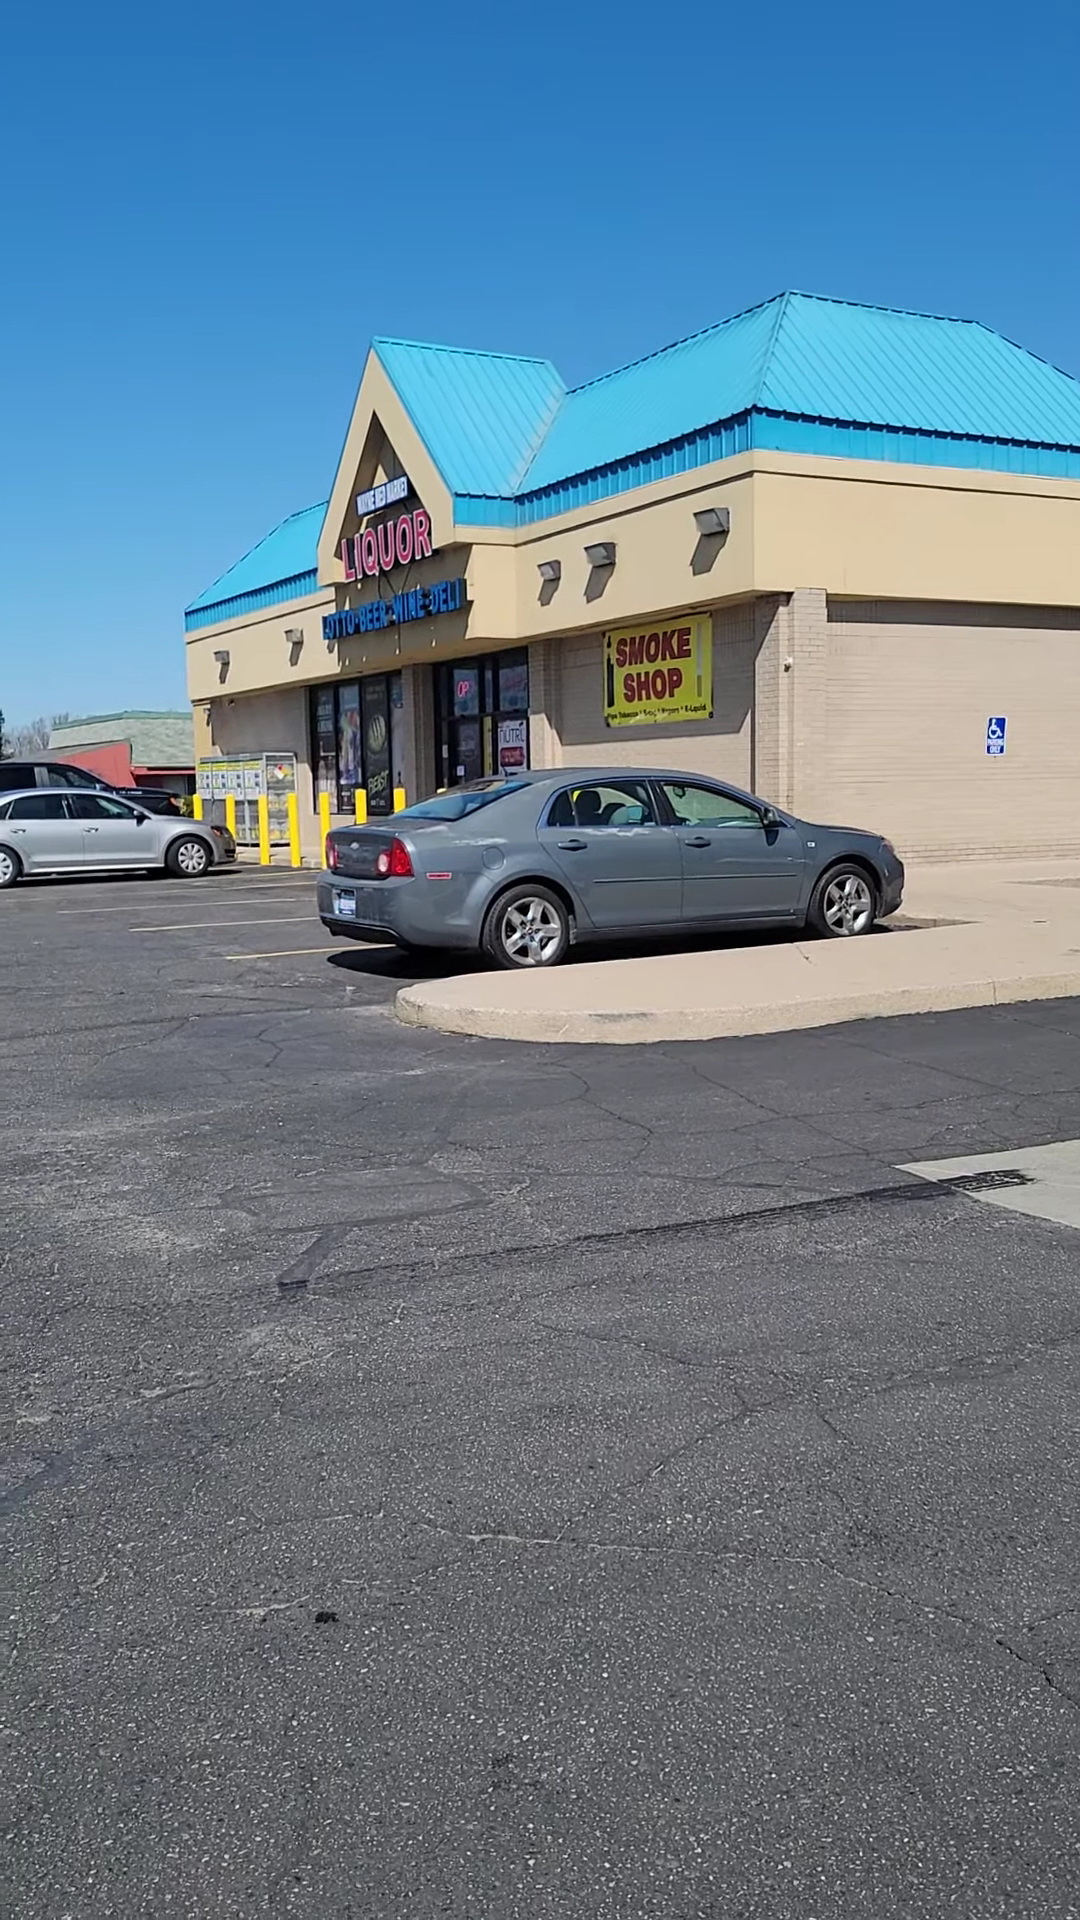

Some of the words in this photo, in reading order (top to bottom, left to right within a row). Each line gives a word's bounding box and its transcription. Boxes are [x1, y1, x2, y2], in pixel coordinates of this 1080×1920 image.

[341, 509, 433, 583] LIQUOR
[615, 627, 692, 668] SMOKE
[623, 667, 683, 703] SHOP
